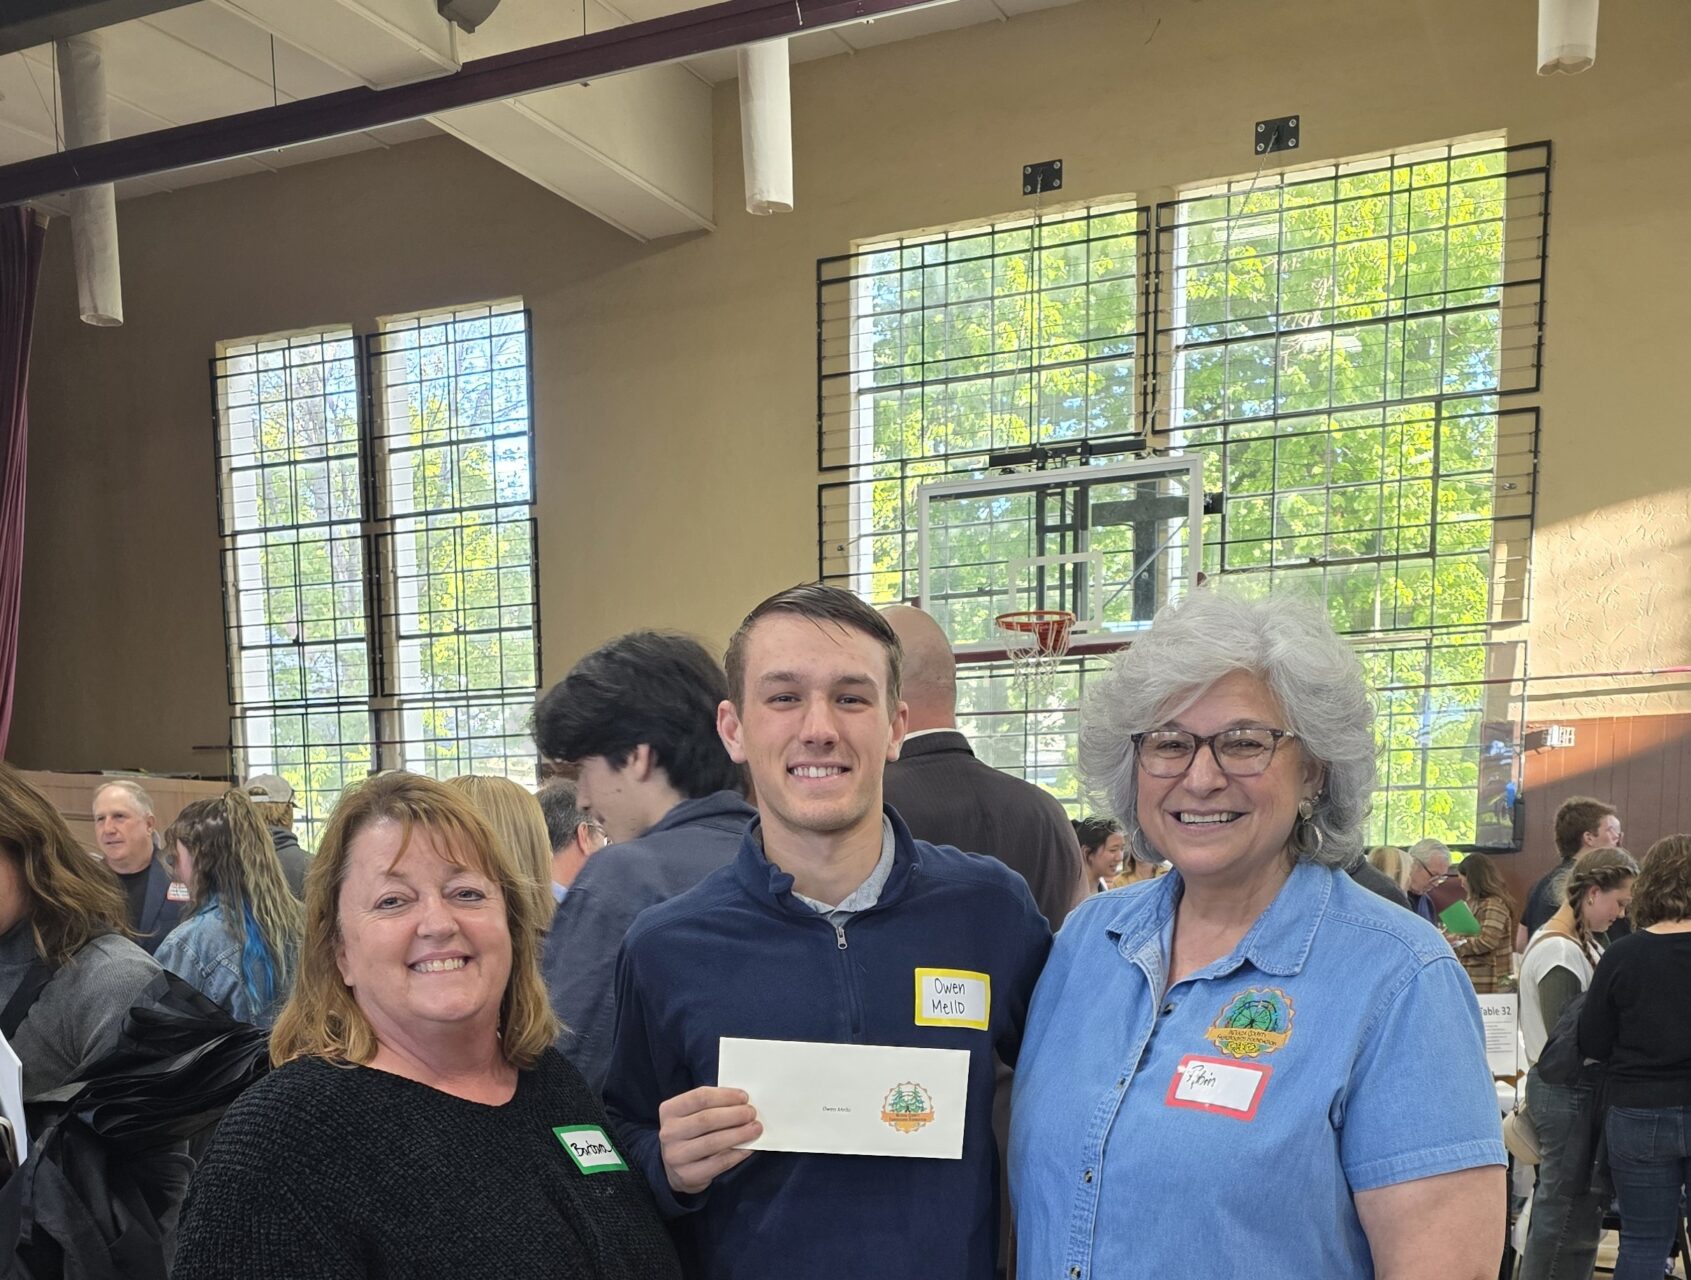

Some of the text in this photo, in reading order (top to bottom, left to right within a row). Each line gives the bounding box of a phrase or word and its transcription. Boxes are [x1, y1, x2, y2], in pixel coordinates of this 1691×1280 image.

[934, 978, 966, 995] Owen
[931, 999, 966, 1015] Mello
[1501, 1006, 1512, 1016] 32
